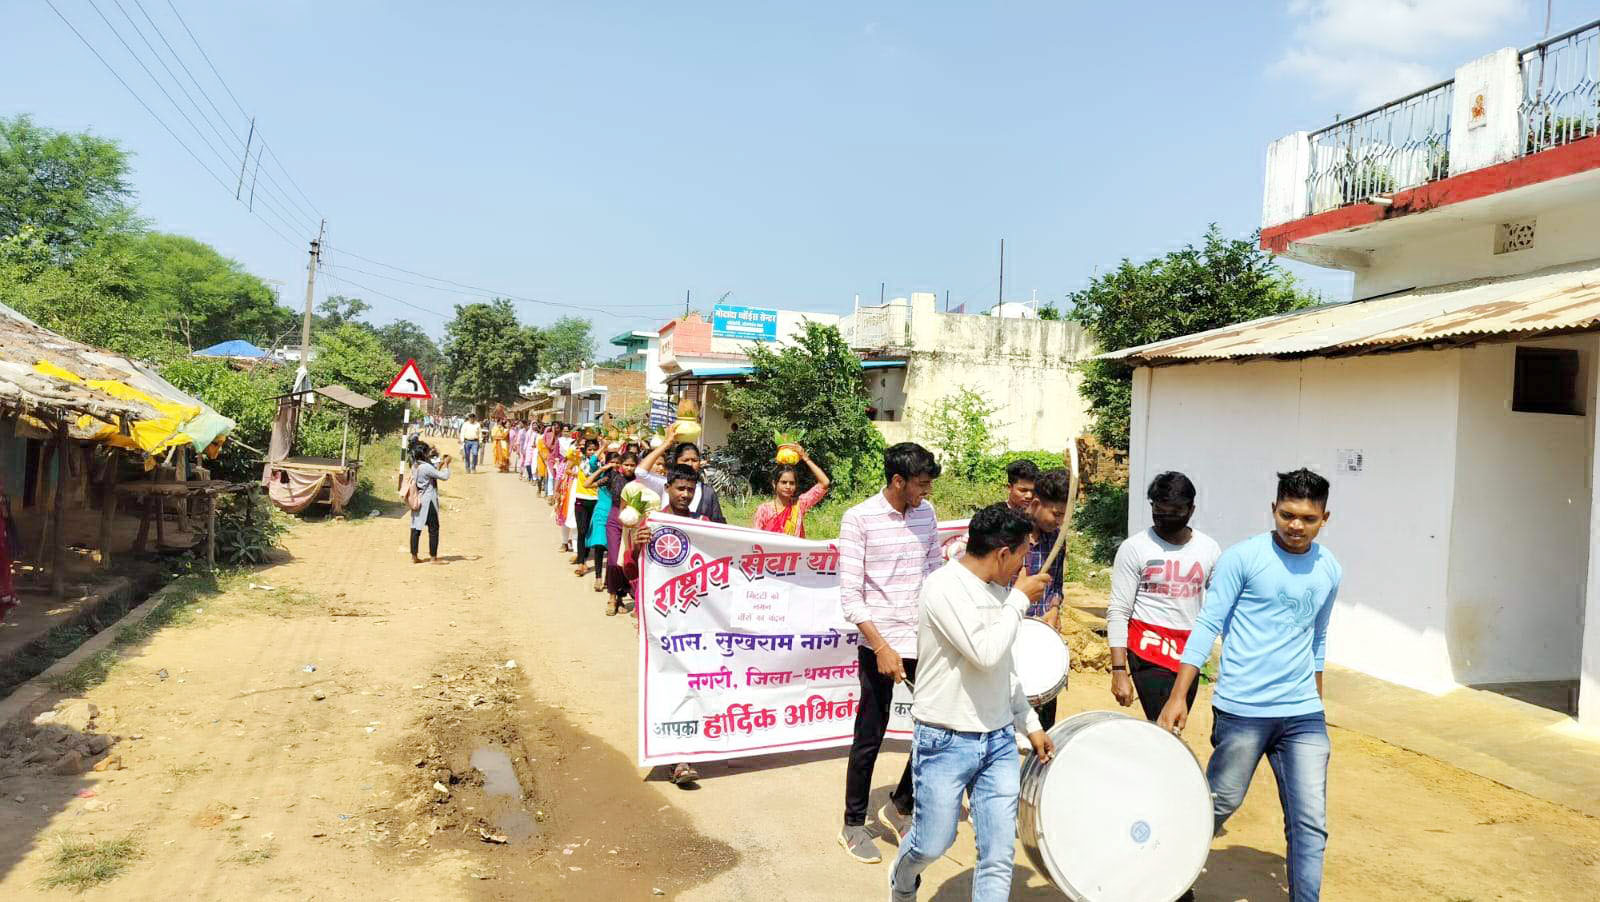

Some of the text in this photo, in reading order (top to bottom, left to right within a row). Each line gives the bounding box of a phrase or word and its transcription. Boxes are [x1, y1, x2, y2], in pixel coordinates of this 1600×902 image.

[654, 544, 841, 615] राष्ट्रीय सेवा यो
[1142, 559, 1204, 584] FILA
[661, 633, 707, 653] शास.
[715, 632, 794, 657] सुखराम
[801, 628, 841, 649] नागे
[1140, 630, 1184, 660] FIL
[652, 720, 699, 736] आपका
[702, 703, 777, 739] हार्दिक
[785, 692, 860, 726] अभिनं
